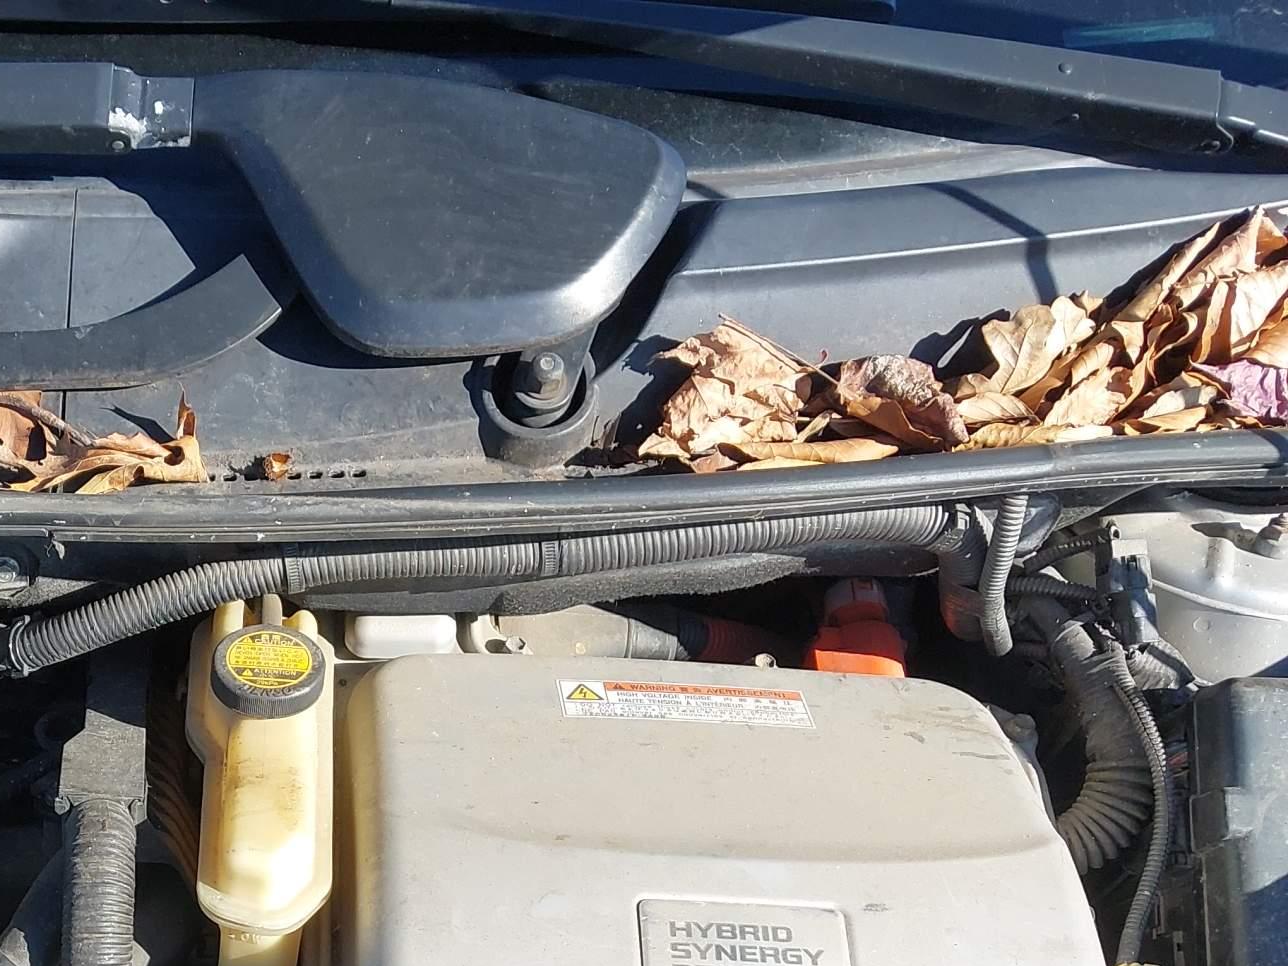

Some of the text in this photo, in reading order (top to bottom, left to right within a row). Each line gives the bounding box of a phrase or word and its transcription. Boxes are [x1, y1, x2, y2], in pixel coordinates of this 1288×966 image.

[253, 668, 297, 677] ATTENTION
[630, 683, 676, 692] WARNING
[668, 920, 793, 943] HYBRID
[669, 942, 825, 966] SYNERGY
